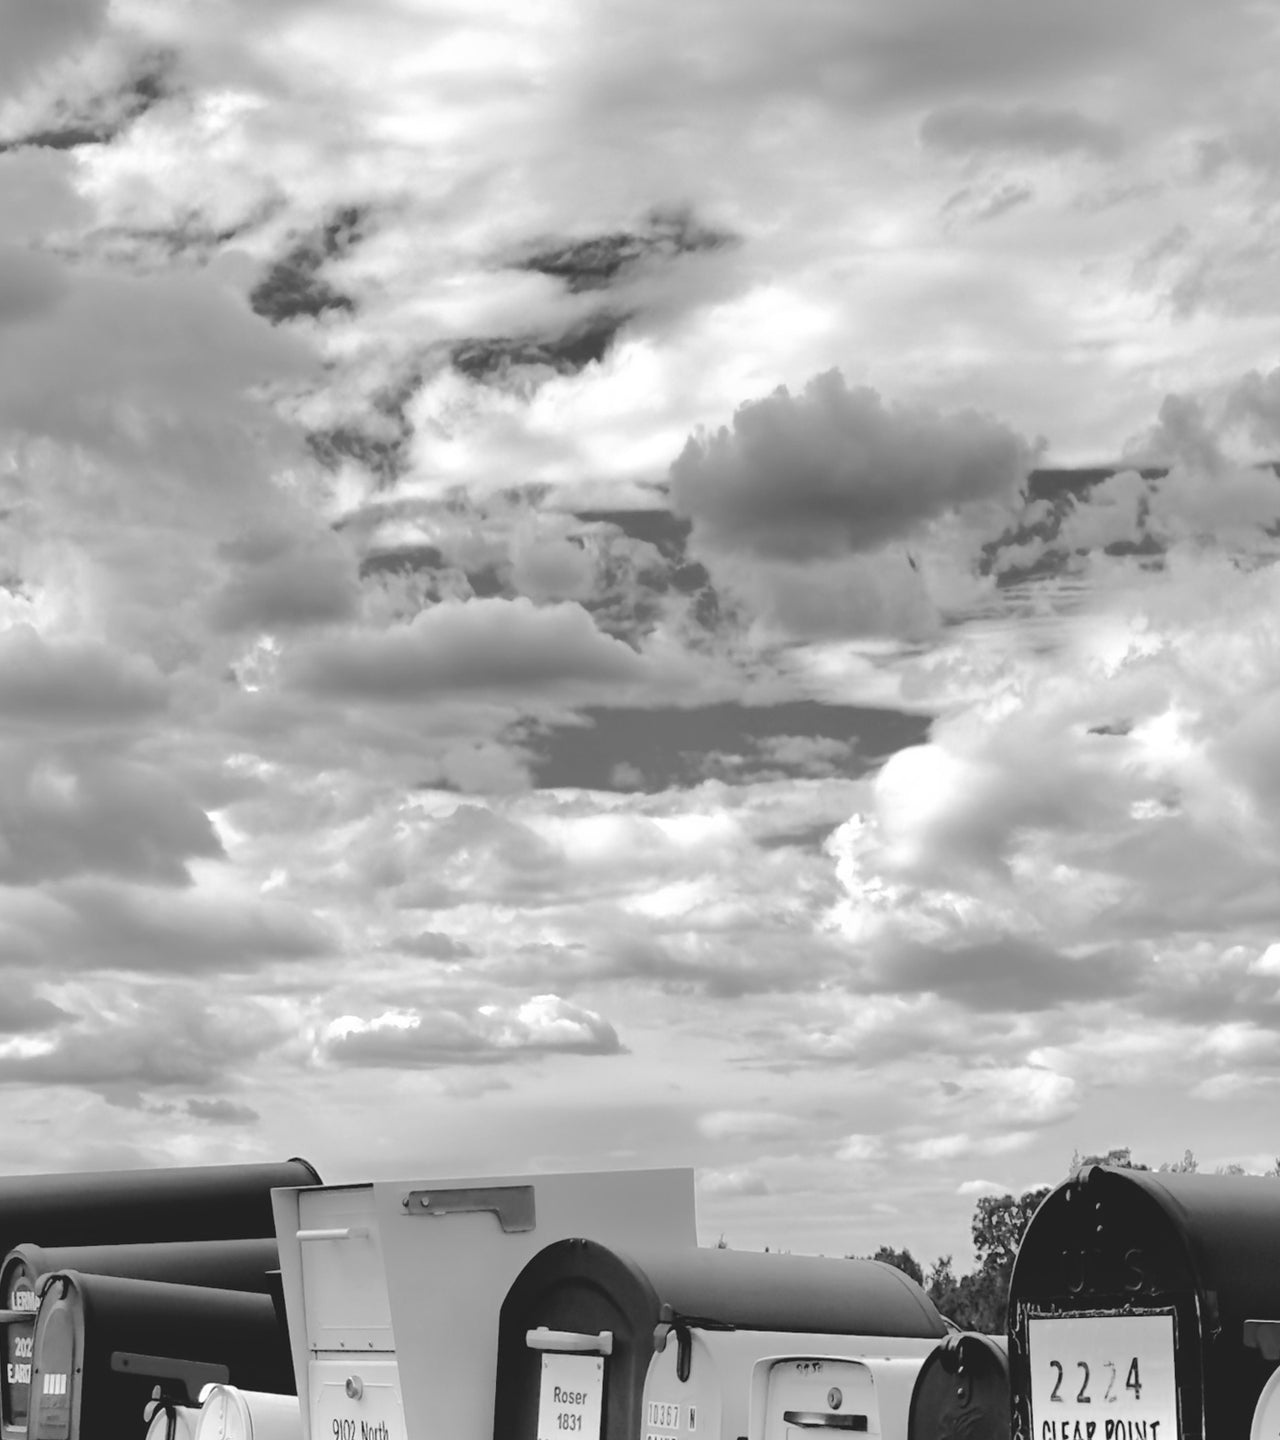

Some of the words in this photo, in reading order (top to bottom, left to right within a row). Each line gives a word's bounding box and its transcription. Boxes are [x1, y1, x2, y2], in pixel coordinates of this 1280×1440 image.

[1049, 1357, 1142, 1403] 2224
[553, 1386, 587, 1405] Roser
[557, 1413, 582, 1431] 1831
[648, 1403, 680, 1428] 10367
[689, 1407, 697, 1430] N
